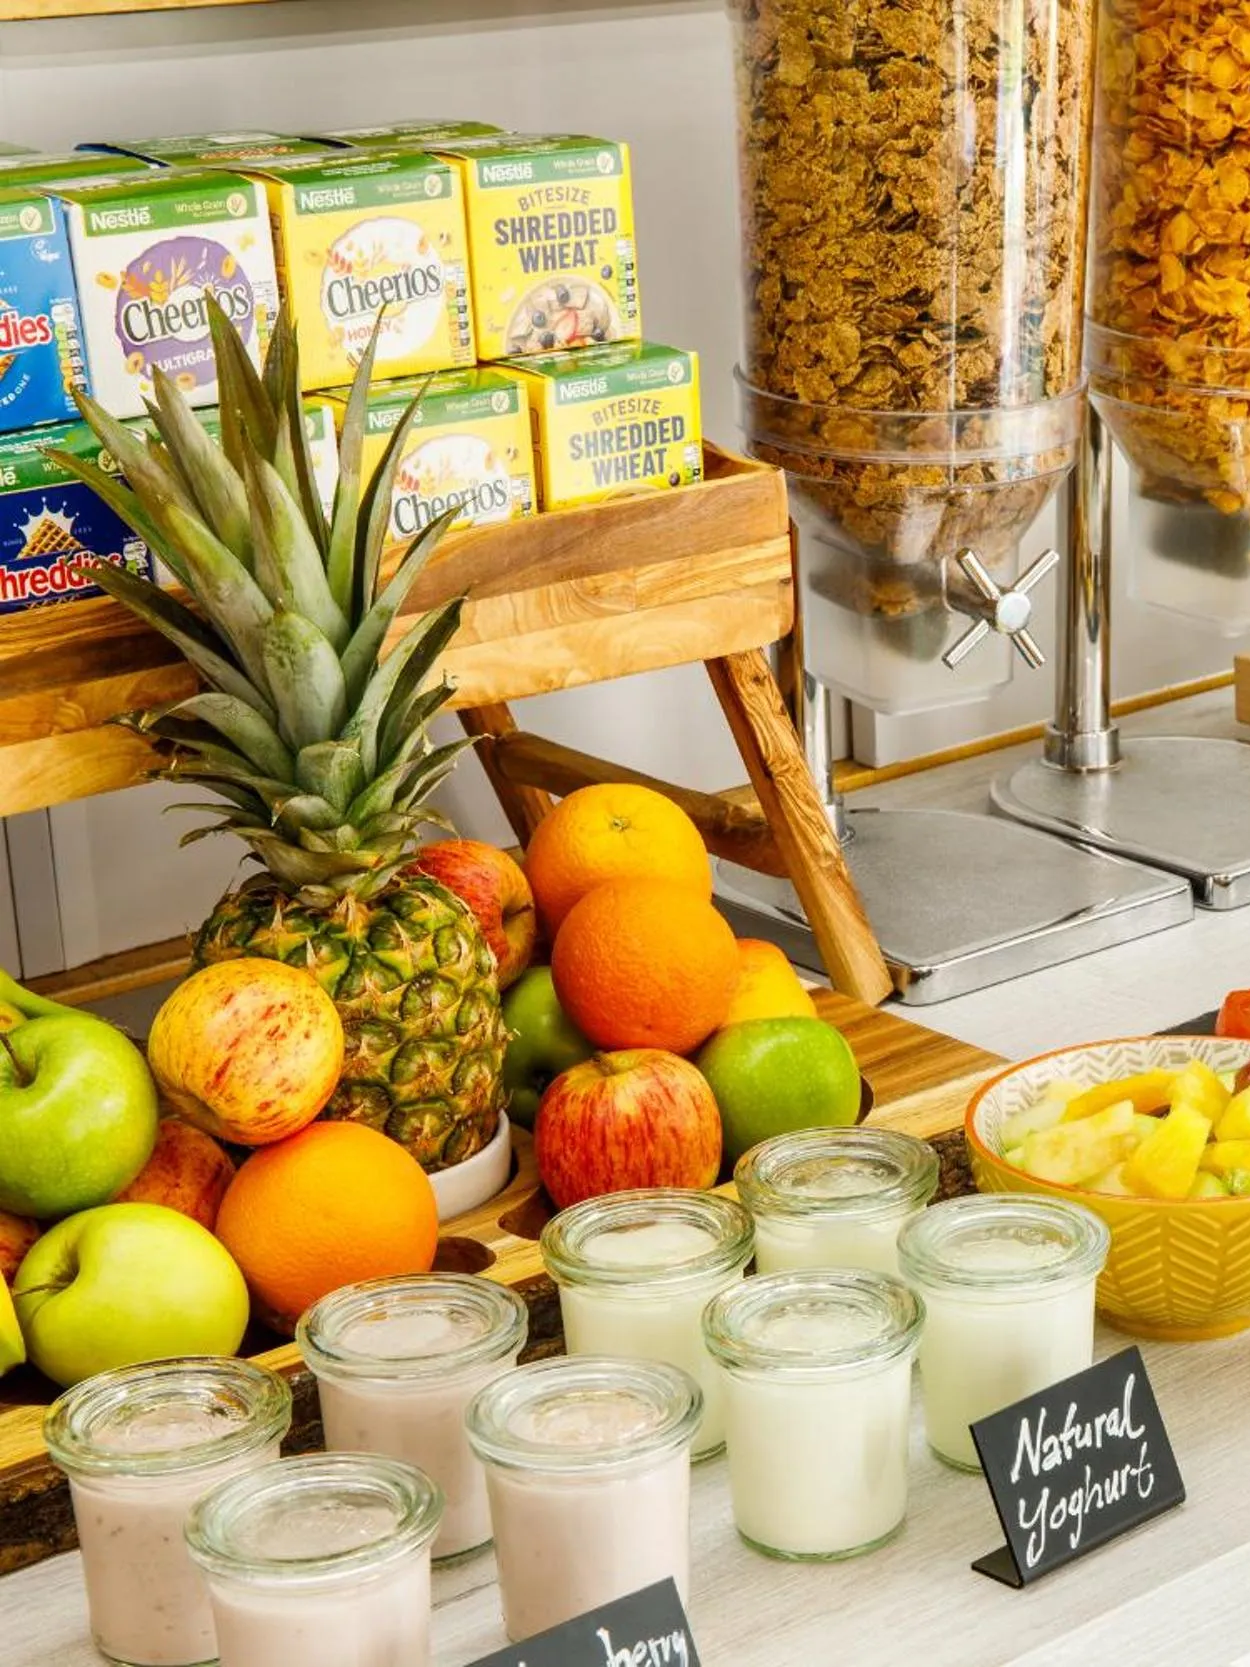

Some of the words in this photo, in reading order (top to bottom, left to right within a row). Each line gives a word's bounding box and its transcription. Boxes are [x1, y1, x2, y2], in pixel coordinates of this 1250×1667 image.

[90, 206, 152, 231] Nestlé
[517, 186, 591, 212] BITESIZE
[494, 207, 617, 246] SHREDDED
[518, 239, 599, 274] WHEAT
[327, 264, 441, 318] Cheerios
[123, 286, 250, 343] Cheeros
[592, 398, 662, 427] BITESIZE
[569, 415, 685, 461] SHREDDED
[592, 448, 667, 487] WHEAT
[1010, 1373, 1146, 1484] Natural
